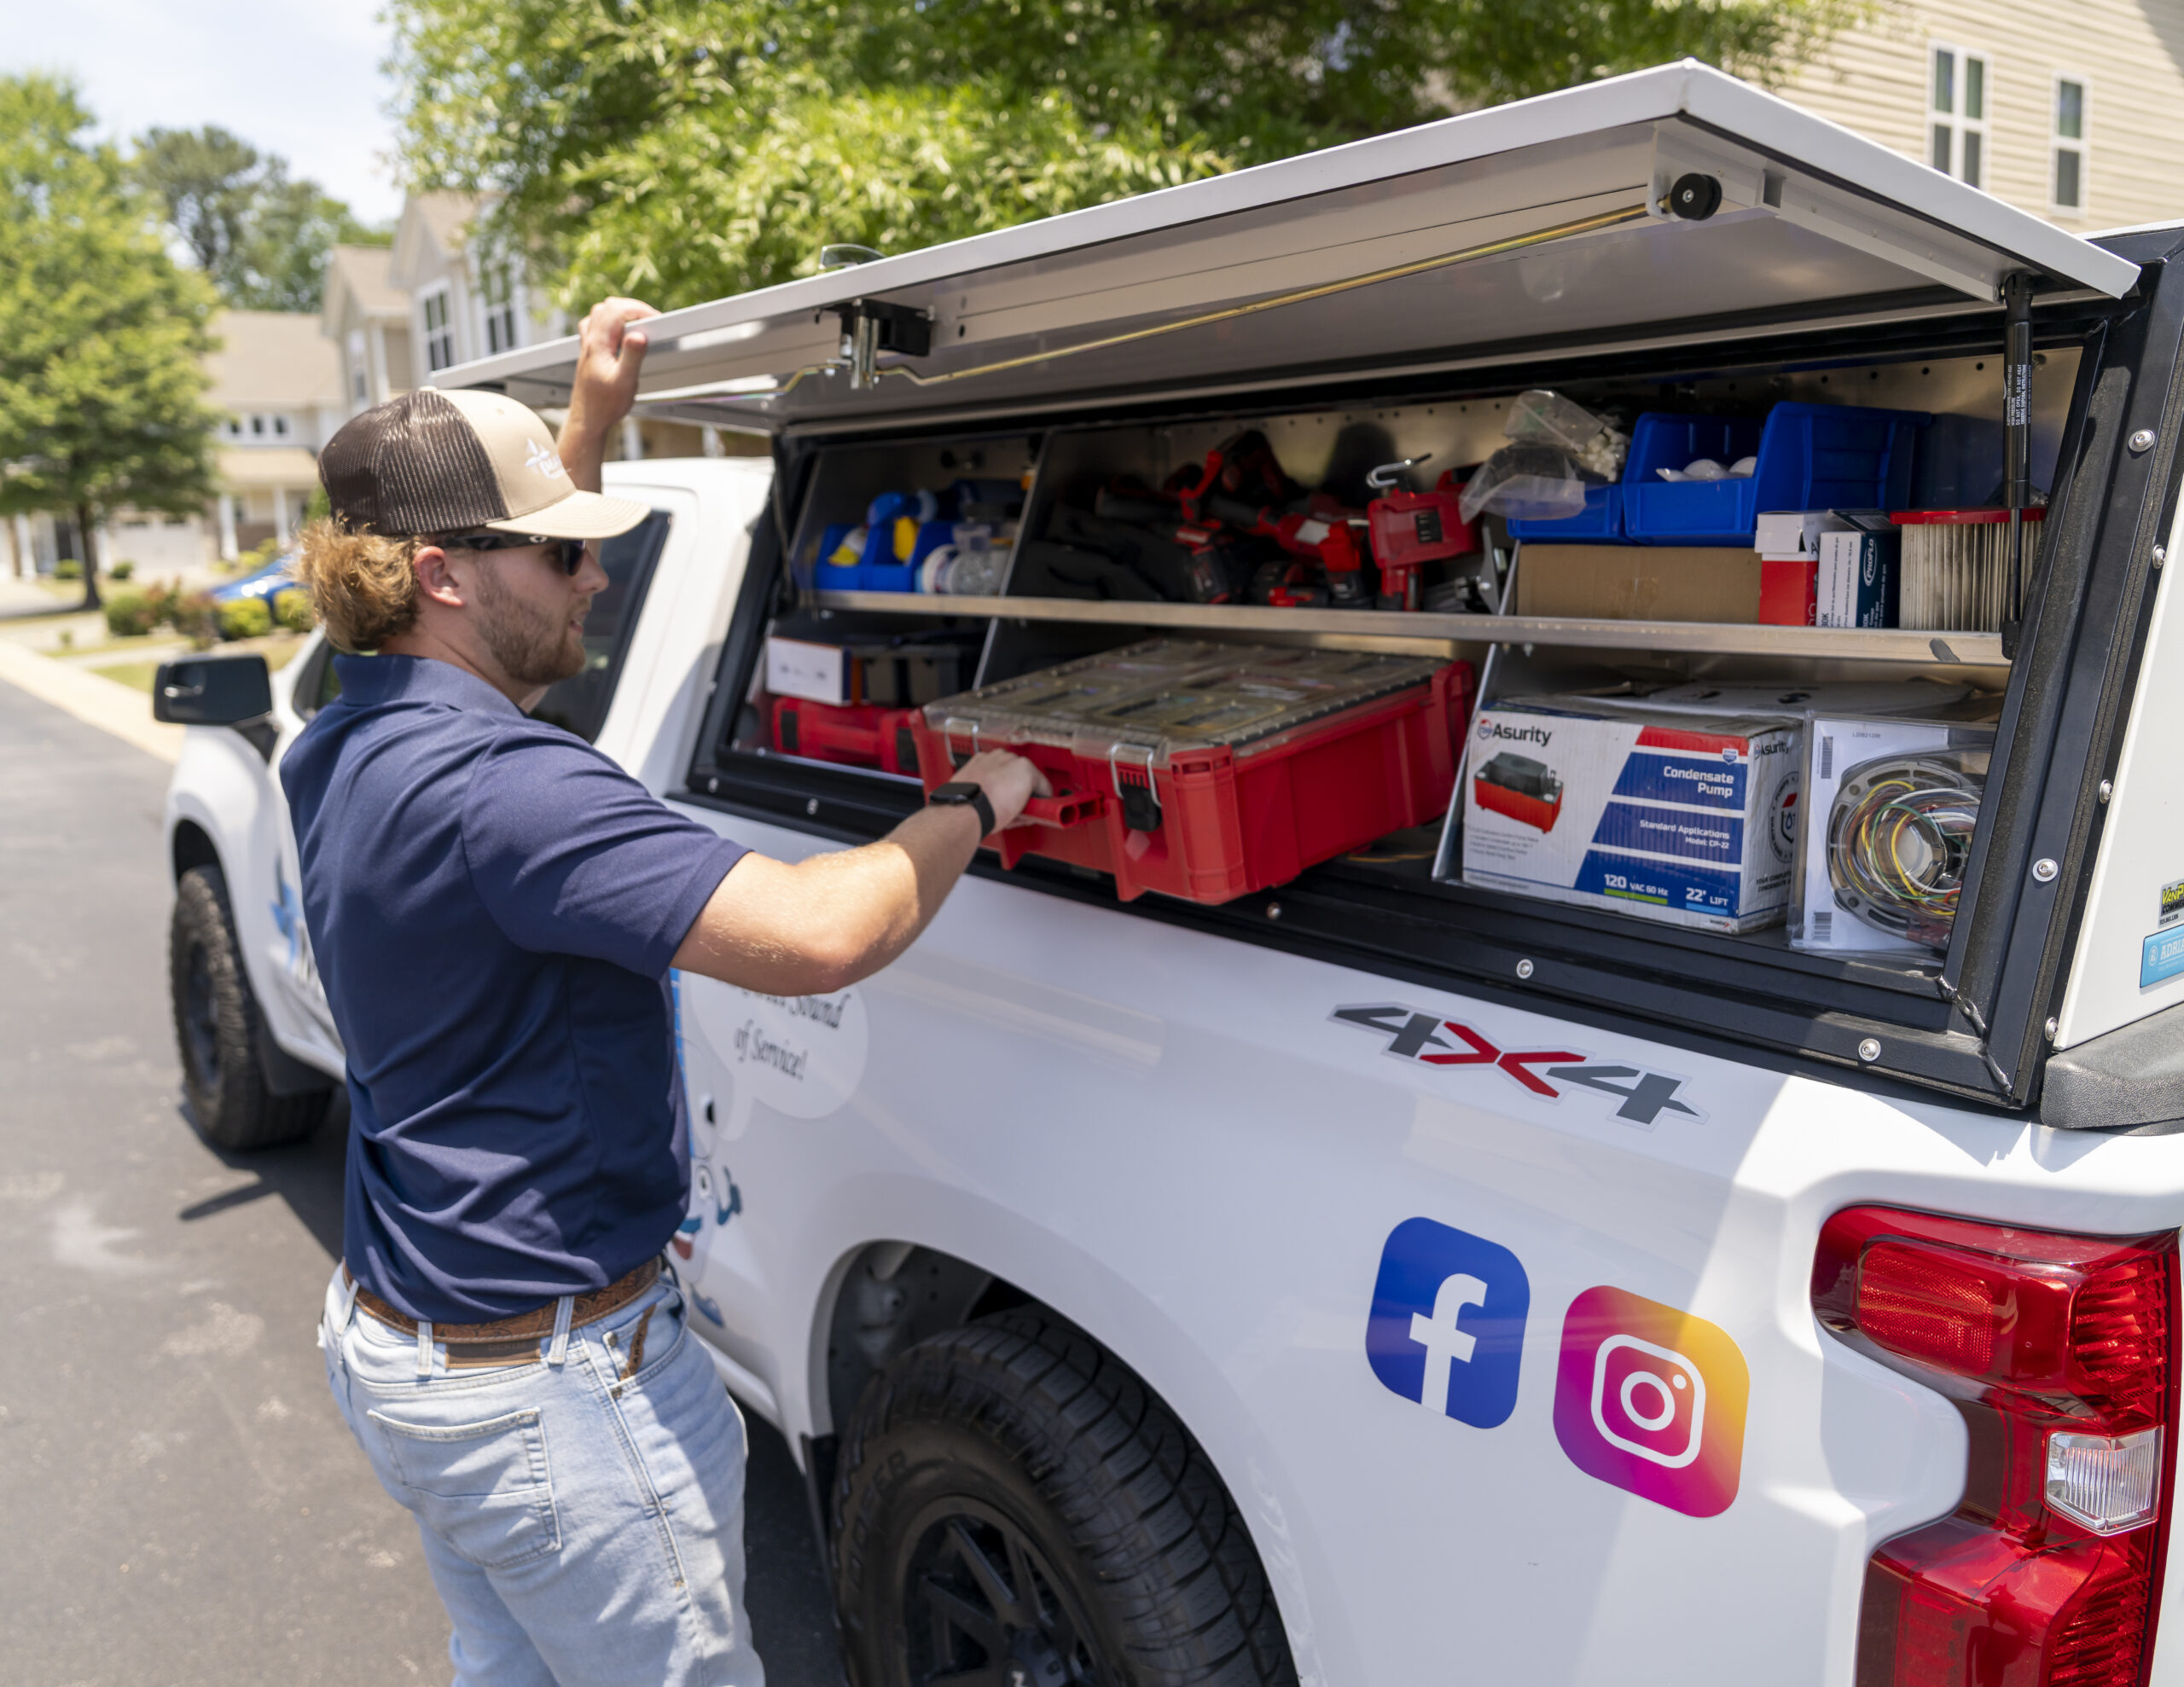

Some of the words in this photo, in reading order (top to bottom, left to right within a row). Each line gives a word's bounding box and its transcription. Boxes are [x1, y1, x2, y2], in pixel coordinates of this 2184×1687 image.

[1492, 722, 1552, 747] Asurity
[1663, 765, 1734, 784] Condensate
[1697, 782, 1733, 798] Pump
[1639, 819, 1676, 832] Standard
[1677, 825, 1730, 839] Applications
[1685, 836, 1707, 846] Model:
[1709, 839, 1729, 849] CP-22
[1604, 873, 1628, 890] 120
[1629, 882, 1646, 892] VAC
[1646, 885, 1657, 895] 60
[1658, 888, 1669, 896] Hz
[1686, 887, 1706, 902] 22'
[1710, 896, 1728, 907] LIFT
[733, 1019, 754, 1063] of
